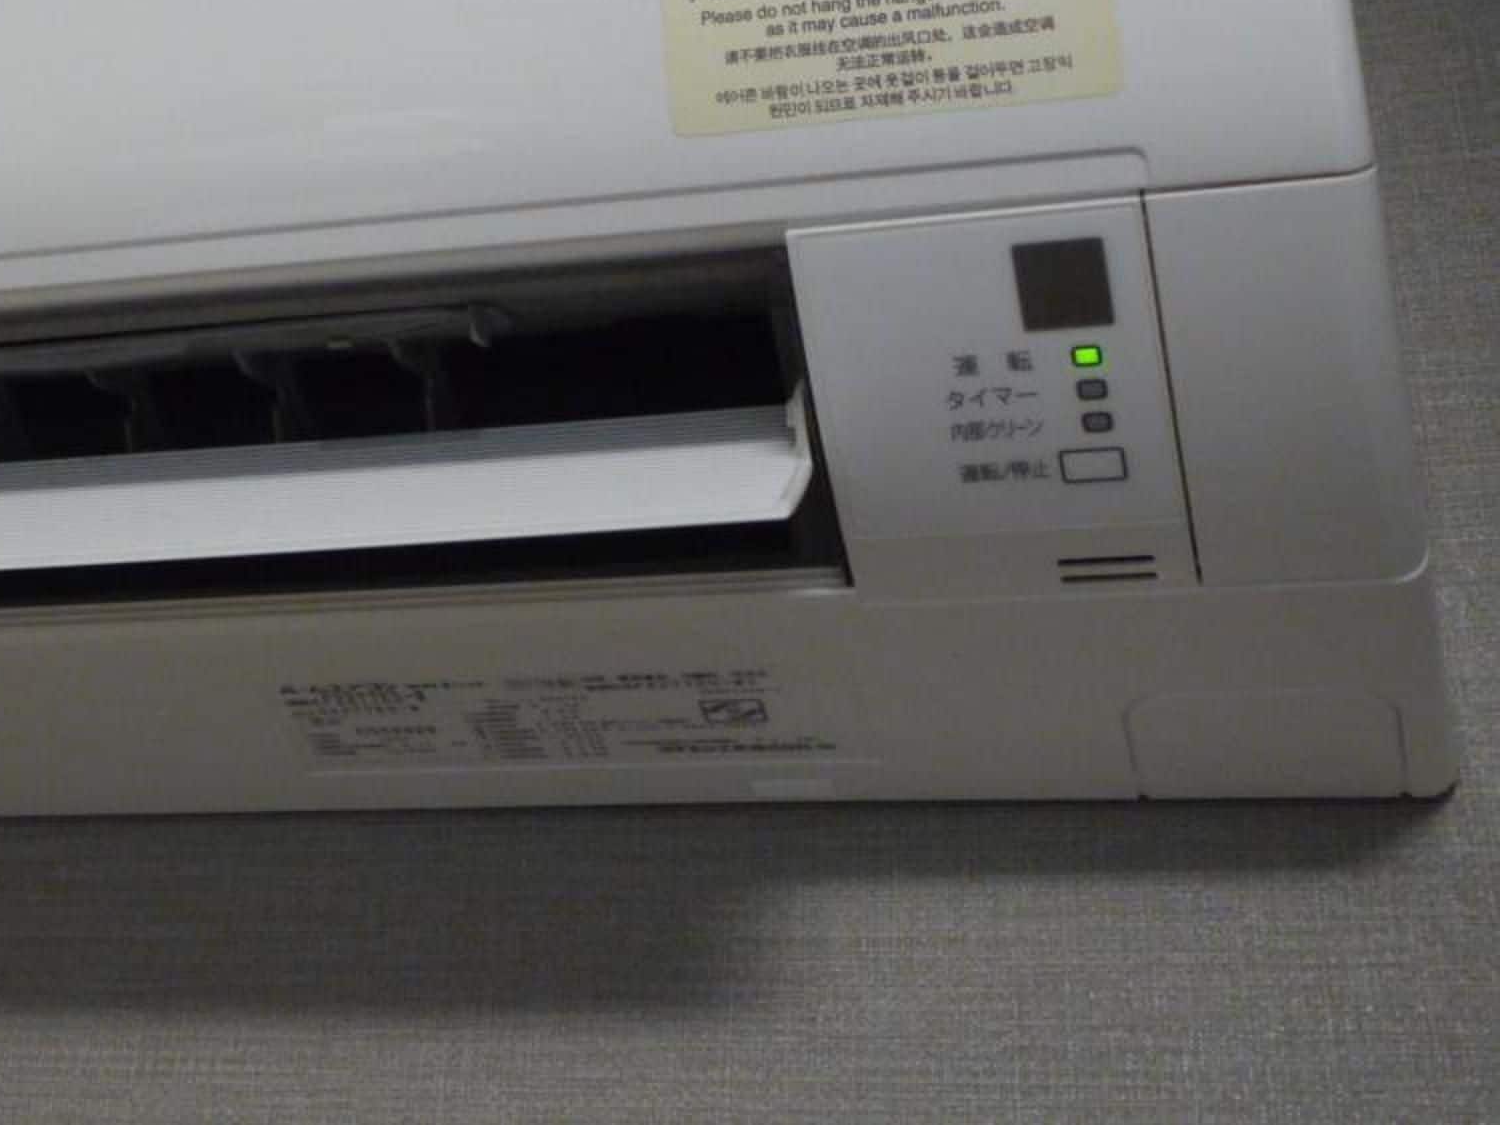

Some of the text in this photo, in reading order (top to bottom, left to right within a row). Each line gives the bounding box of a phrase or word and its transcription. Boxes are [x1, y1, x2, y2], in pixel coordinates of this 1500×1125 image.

[700, 6, 752, 25] Please
[756, 4, 777, 18] do
[781, 2, 806, 16] not
[765, 24, 784, 36] as
[787, 21, 797, 33] it
[802, 18, 835, 34] may
[839, 12, 888, 28] cause
[891, 10, 902, 22] a
[806, 78, 847, 94] 나오는
[948, 387, 1038, 411] タイマー
